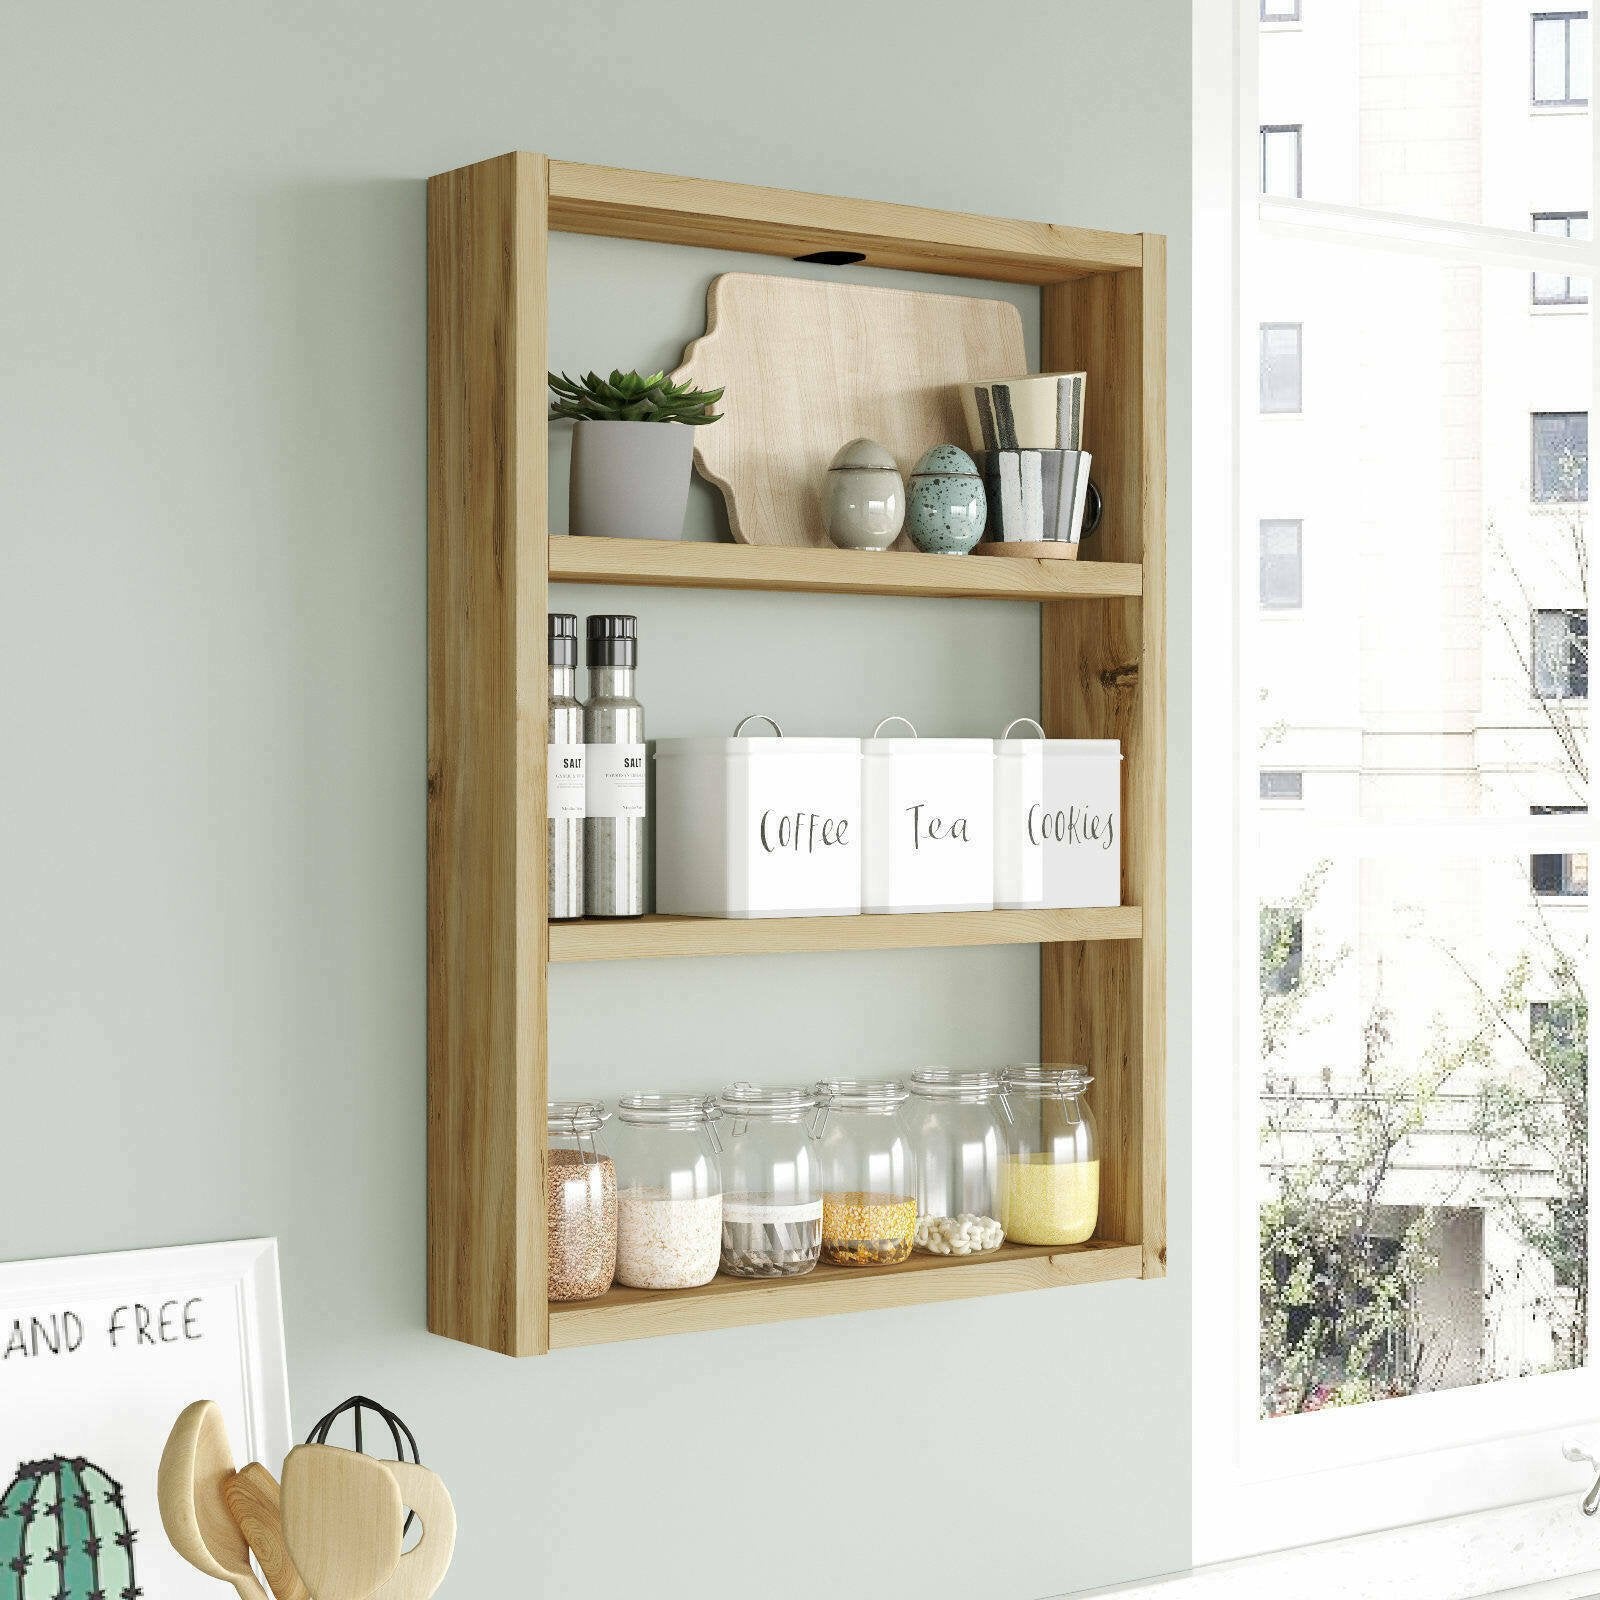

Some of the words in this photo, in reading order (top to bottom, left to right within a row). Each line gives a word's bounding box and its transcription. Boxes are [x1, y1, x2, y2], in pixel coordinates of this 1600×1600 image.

[563, 758, 582, 769] SALT
[624, 757, 642, 768] SALT
[905, 803, 970, 850] Tea
[1027, 802, 1114, 850] Cookies
[3, 1310, 84, 1359] AND
[109, 1297, 202, 1347] FREE
